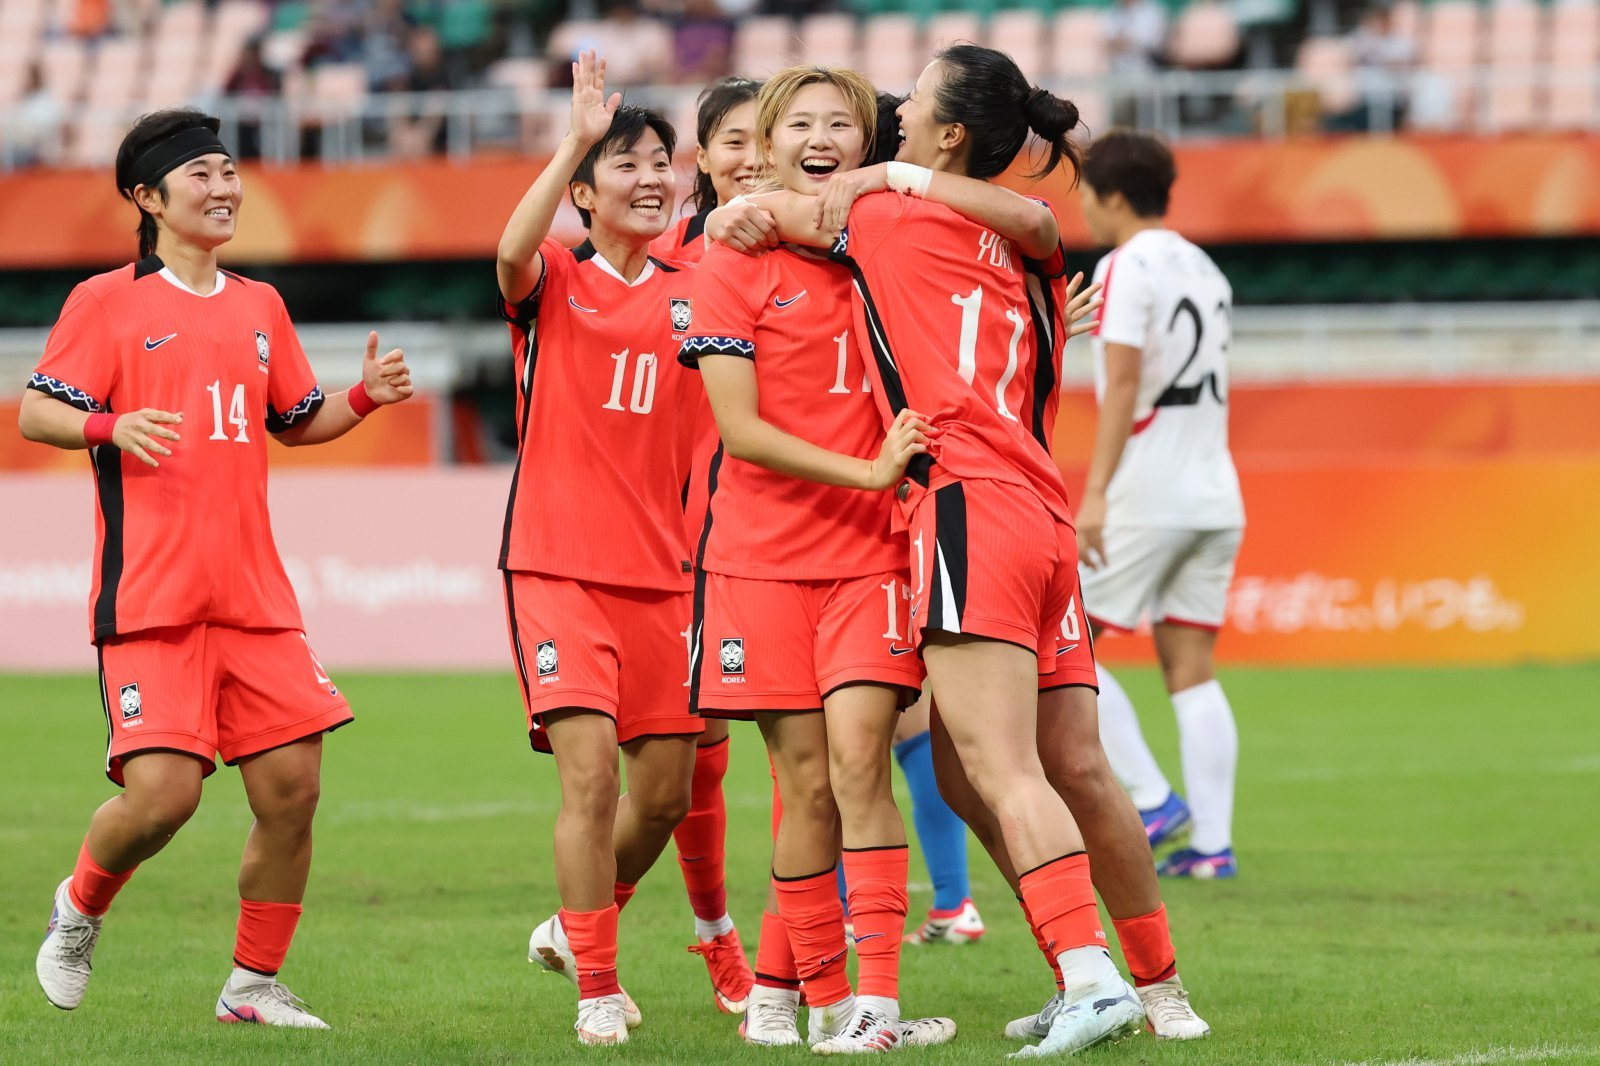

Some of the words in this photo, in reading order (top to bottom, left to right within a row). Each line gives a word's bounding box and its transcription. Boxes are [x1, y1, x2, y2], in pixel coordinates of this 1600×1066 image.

[601, 347, 658, 415] 10
[828, 328, 872, 394] 1
[951, 284, 1025, 423] 11
[206, 378, 250, 443] 14
[1056, 594, 1080, 641] 8
[721, 676, 746, 684] KOREA
